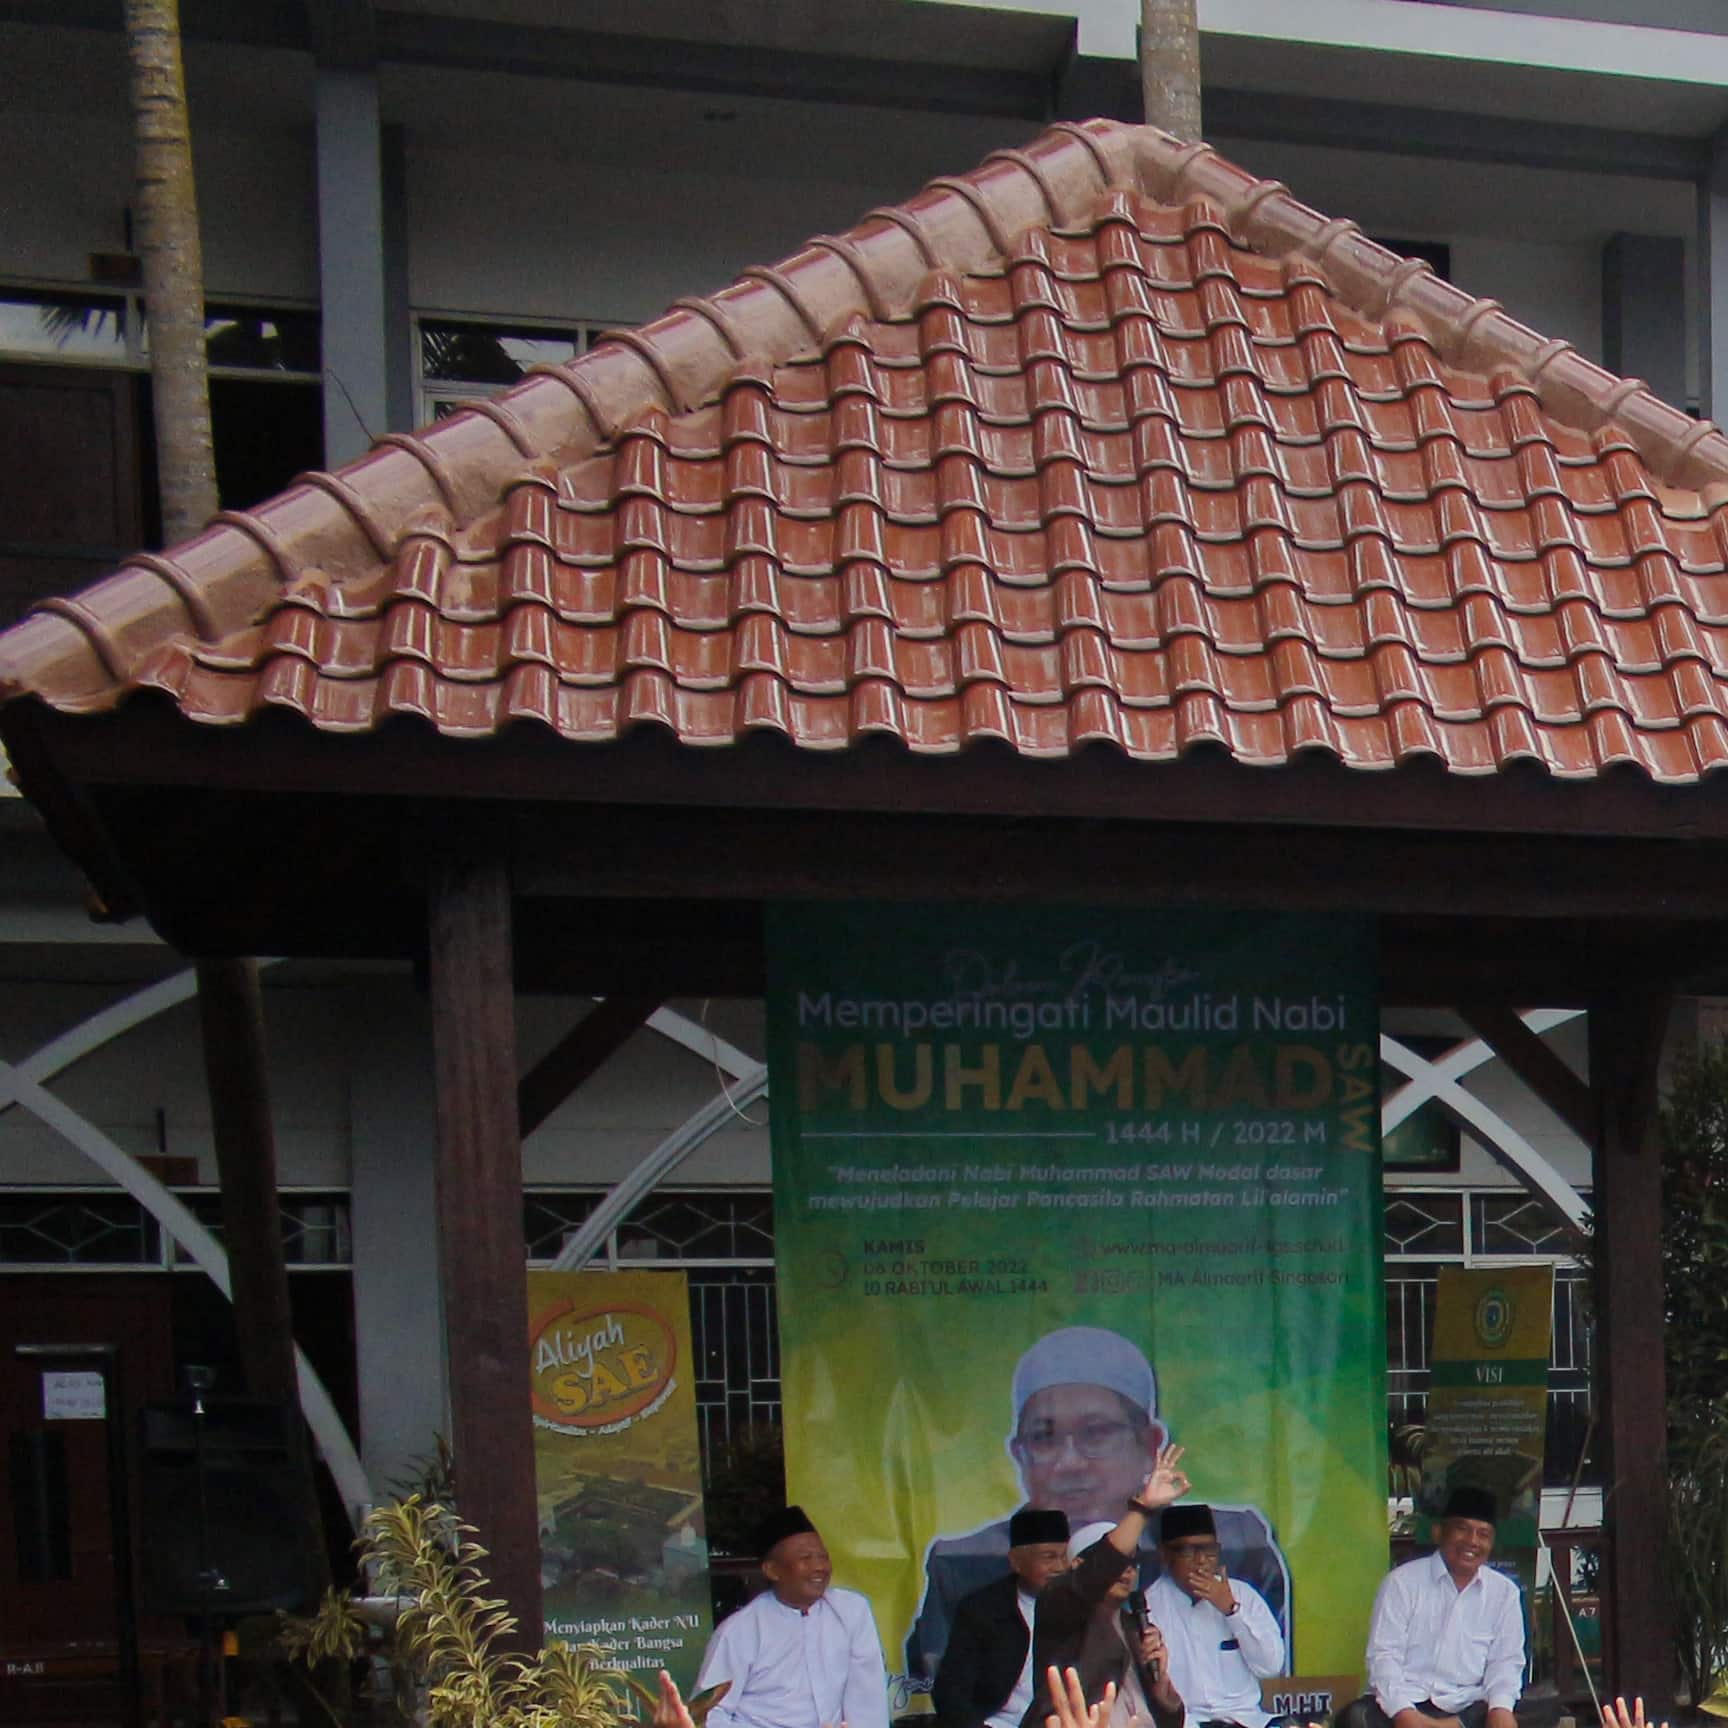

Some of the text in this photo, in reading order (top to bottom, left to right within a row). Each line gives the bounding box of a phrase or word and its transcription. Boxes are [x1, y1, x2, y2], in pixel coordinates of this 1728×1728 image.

[800, 994, 1344, 1037] Memperingati Maulid Nabi
[802, 1043, 1332, 1110] MUHAMMAD
[1338, 1042, 1373, 1152] SAW
[1105, 1120, 1327, 1148] 1444 H / 2022 M
[961, 1164, 1013, 1183] Nabi
[1019, 1163, 1140, 1182] Muhammad
[1145, 1163, 1191, 1181] SAW
[1196, 1163, 1259, 1181] Modal
[1265, 1162, 1323, 1181] dasar
[863, 1239, 926, 1255] KAMIS
[890, 1259, 979, 1275] OKTOBER
[535, 1313, 625, 1378] Aliyah
[552, 1343, 659, 1417] SAE
[1476, 1366, 1503, 1384] VISI
[543, 1617, 625, 1635] Menyiapkan
[628, 1615, 669, 1632] Kader
[635, 1635, 684, 1651] Bangsa
